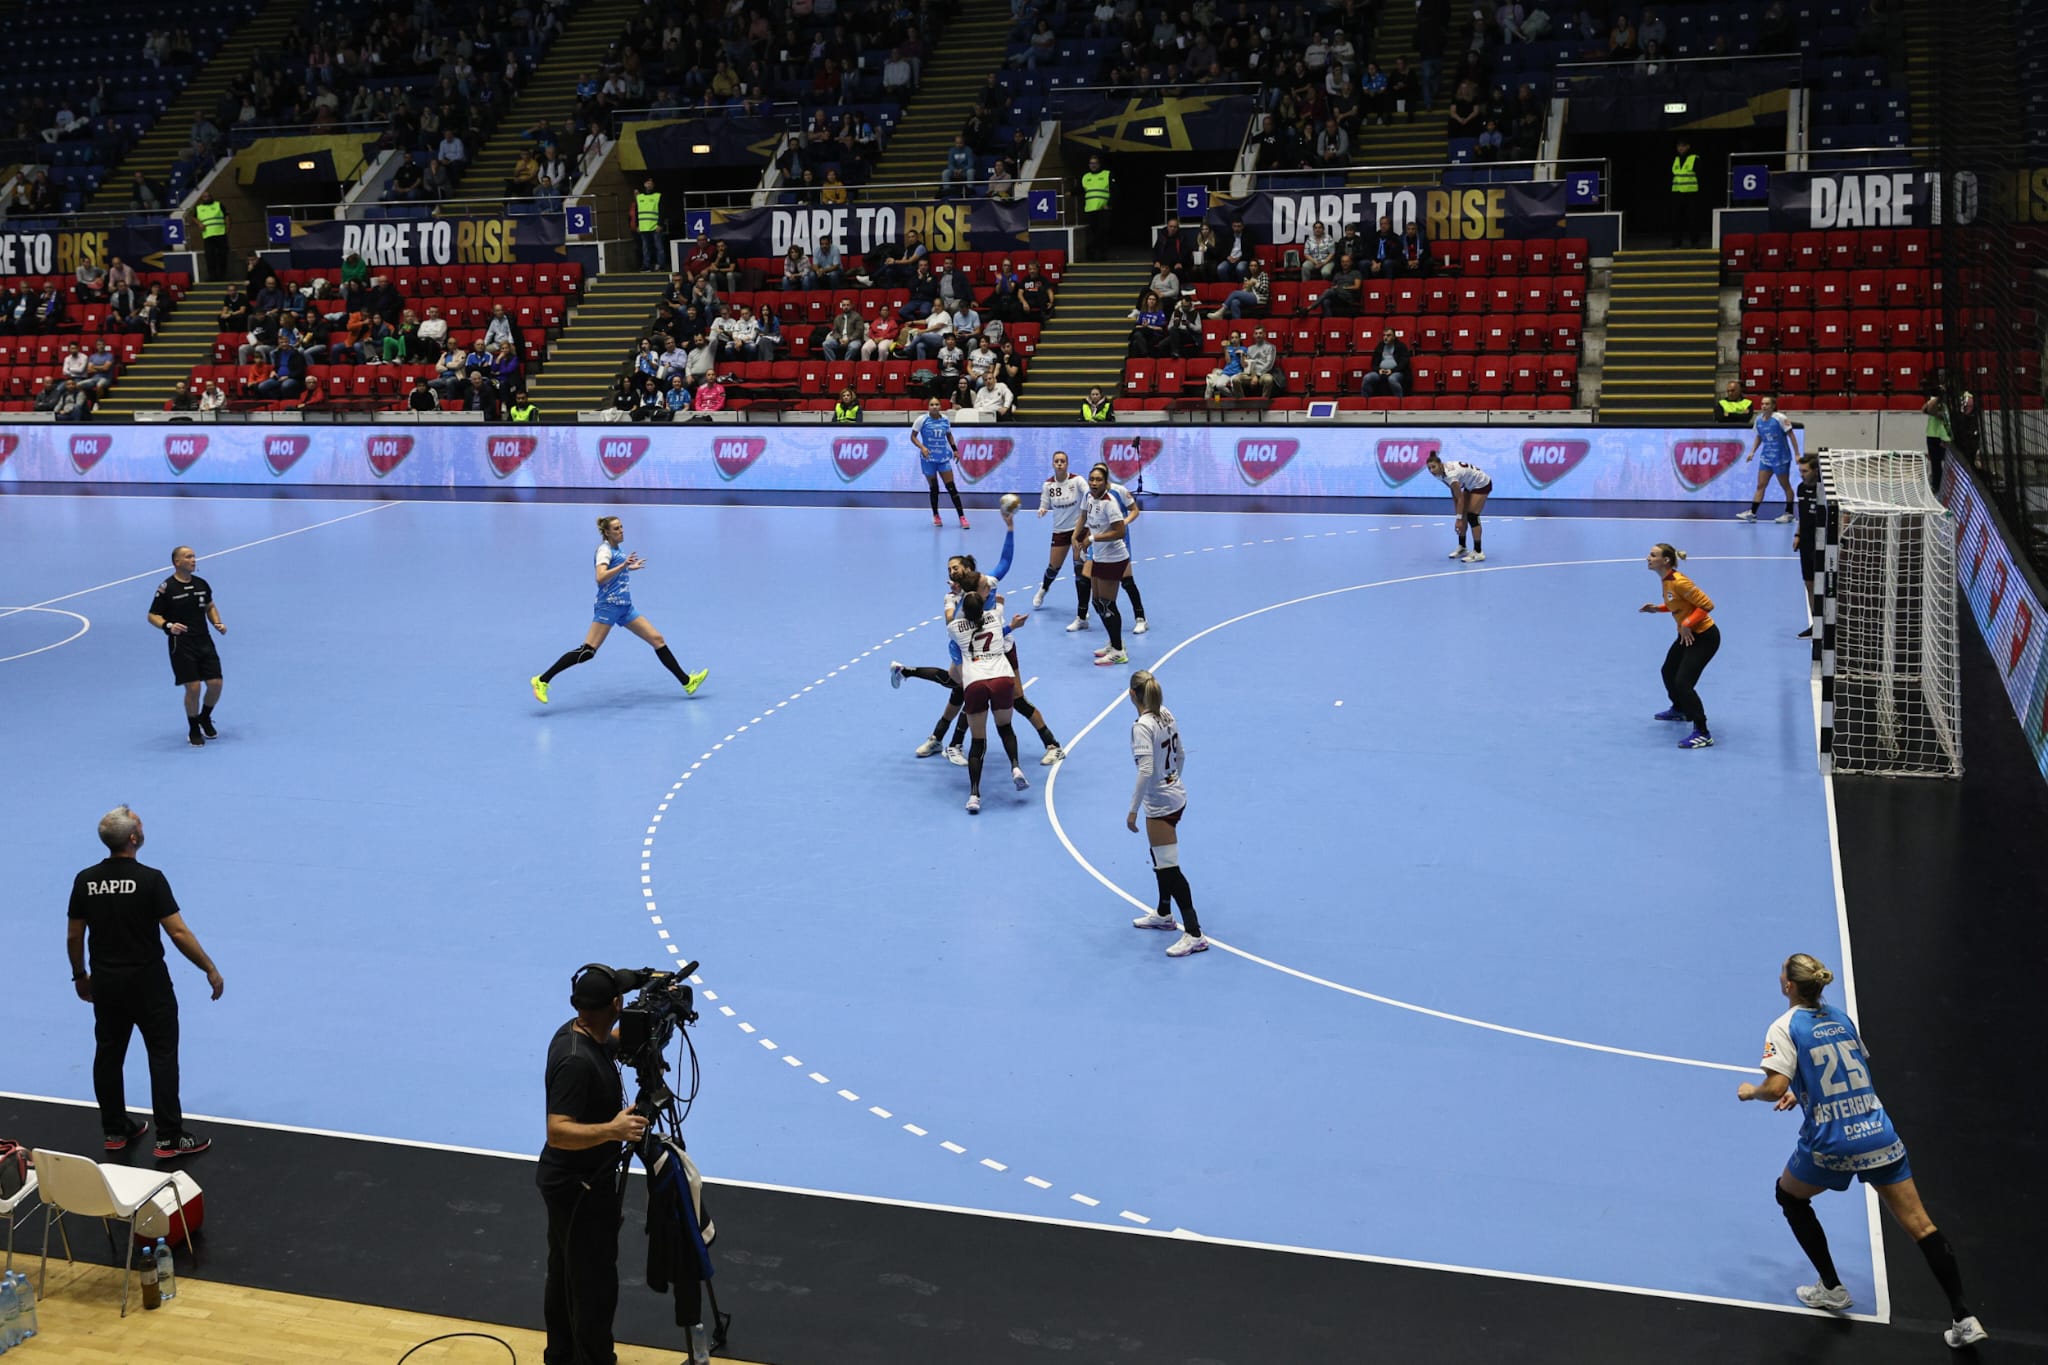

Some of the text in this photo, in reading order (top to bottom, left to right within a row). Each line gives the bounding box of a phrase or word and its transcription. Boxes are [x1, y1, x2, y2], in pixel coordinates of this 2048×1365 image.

[1576, 180, 1589, 195] 5
[1743, 174, 1756, 191] 6
[1036, 198, 1048, 213] 4
[1188, 193, 1198, 208] 5
[1810, 173, 1913, 229] DARE
[574, 214, 584, 227] 3
[1272, 188, 1505, 245] DARE TO RISE
[169, 225, 178, 238] 2
[275, 223, 285, 237] 3
[693, 219, 704, 233] 4
[772, 204, 971, 256] DARE TO RISE
[343, 219, 517, 267] DARE TO RISE
[20, 233, 52, 275] TO
[57, 231, 110, 274] RISE
[74, 439, 98, 455] MOL
[170, 439, 194, 455] MOL
[269, 440, 294, 456] MOL
[372, 441, 398, 457] MOL
[492, 441, 520, 457] MOL
[604, 441, 633, 458] MOL
[718, 442, 748, 459] MOL
[838, 442, 869, 460] MOL
[962, 442, 994, 460] MOL
[1109, 443, 1141, 461] MOL
[1243, 444, 1277, 462] MOL
[1383, 445, 1418, 463] MOL
[1528, 446, 1566, 465] MOL
[1681, 447, 1719, 466] MOL
[1049, 487, 1062, 498] 88
[974, 631, 994, 653] 7
[87, 879, 137, 895] RAPID
[1809, 1039, 1870, 1098] 25
